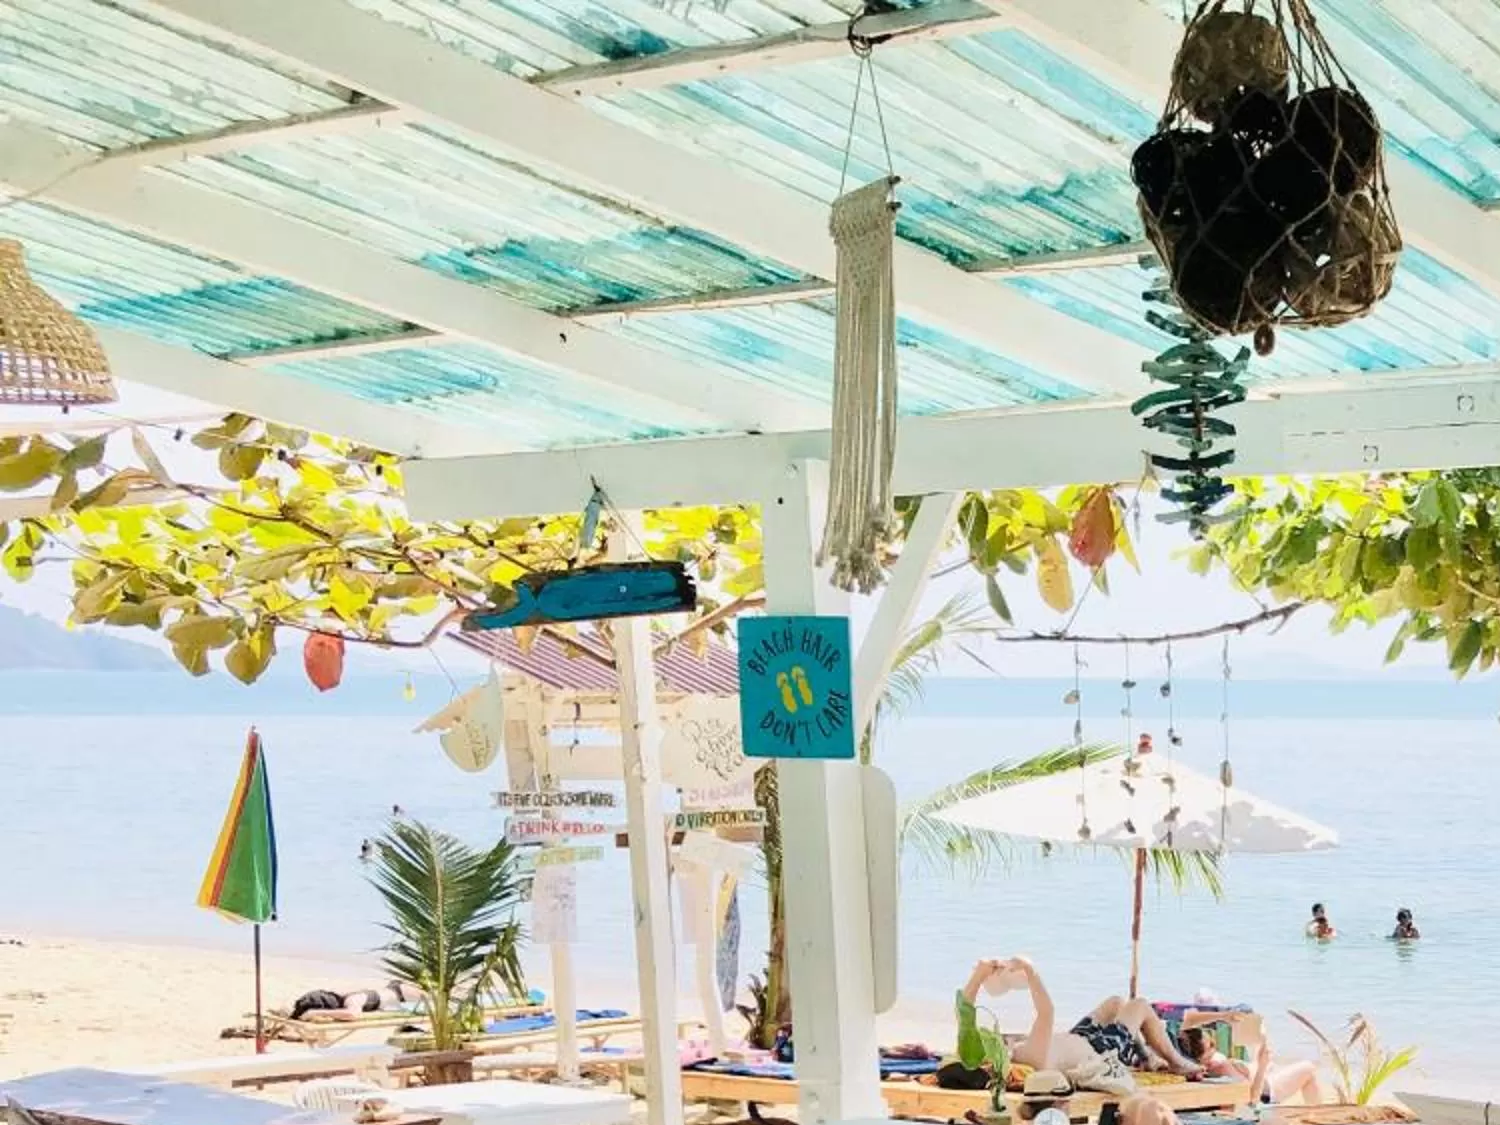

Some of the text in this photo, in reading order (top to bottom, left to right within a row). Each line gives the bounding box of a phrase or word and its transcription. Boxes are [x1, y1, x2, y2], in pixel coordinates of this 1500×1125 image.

[747, 625, 841, 676] BEACH HAIR
[760, 688, 849, 745] DON'T CARE
